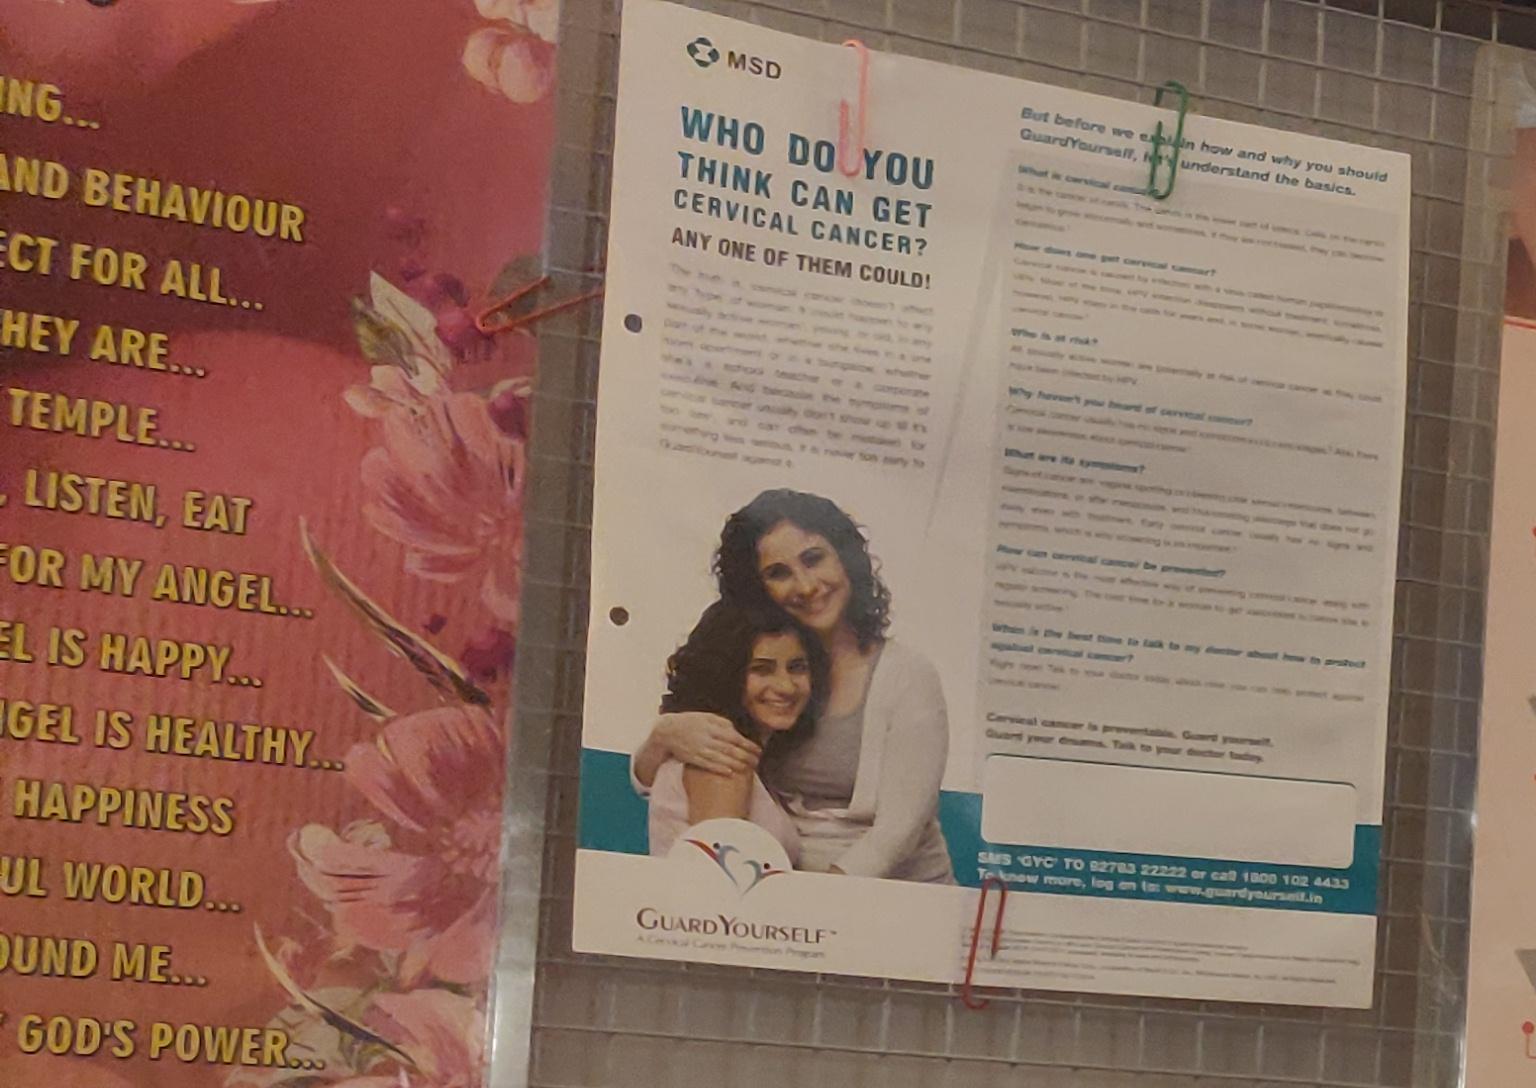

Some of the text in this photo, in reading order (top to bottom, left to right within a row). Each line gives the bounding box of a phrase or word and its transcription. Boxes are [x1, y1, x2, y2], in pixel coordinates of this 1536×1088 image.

[728, 51, 782, 79] MSD
[681, 106, 934, 189] WHO DO YOU
[1200, 140, 1388, 183] how and why you should
[677, 151, 933, 229] THINK CAN GET
[1180, 159, 1357, 197] understand the basics.
[84, 168, 305, 242] BEHAVIOUR
[674, 189, 928, 257] CERVICAL CANCER?
[71, 244, 145, 290] FOR
[671, 227, 931, 289] ANY ONE OF THEM COULD!
[25, 469, 252, 535] LISTEN, EAT
[80, 555, 142, 596] MY
[48, 627, 86, 666] IS
[14, 780, 235, 836] HAPPINESS
[17, 1014, 135, 1059] GOD'S
